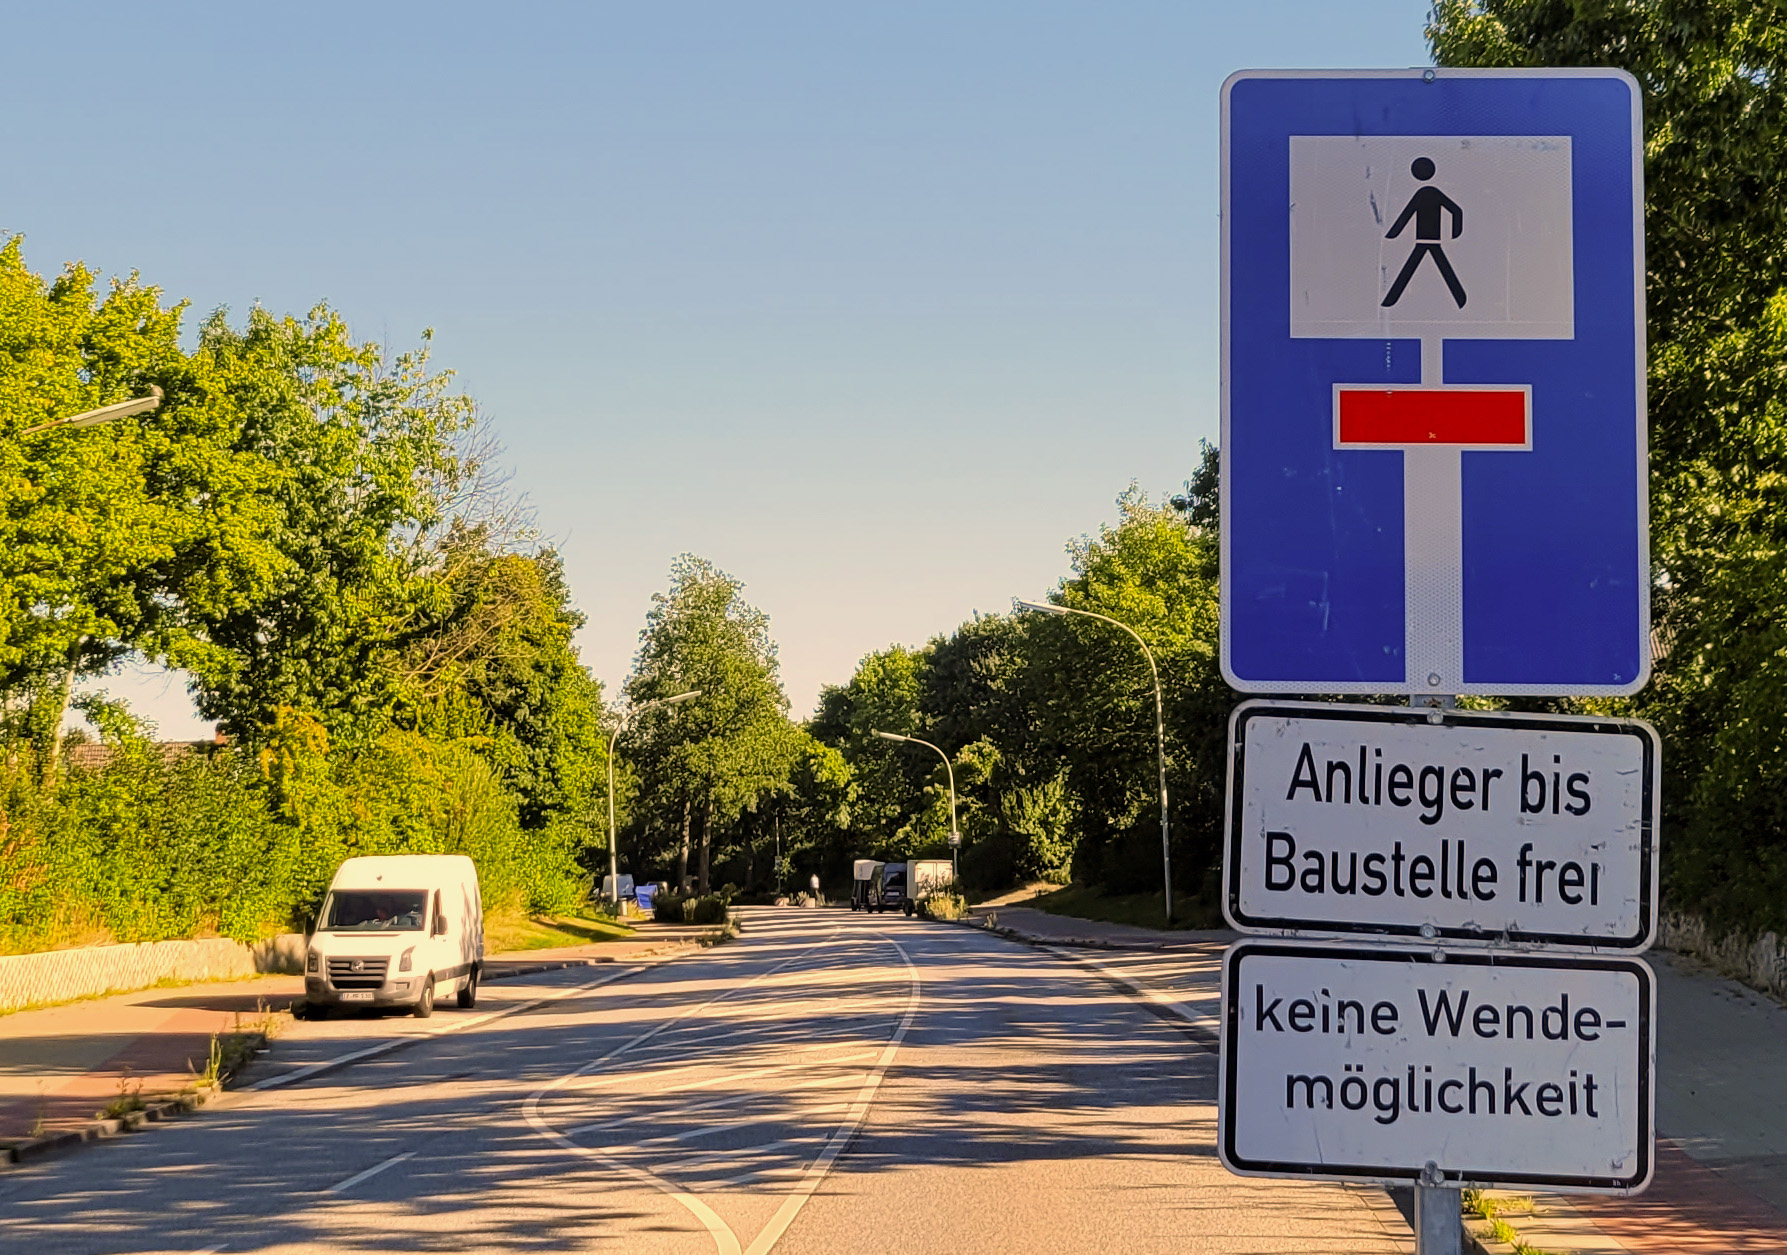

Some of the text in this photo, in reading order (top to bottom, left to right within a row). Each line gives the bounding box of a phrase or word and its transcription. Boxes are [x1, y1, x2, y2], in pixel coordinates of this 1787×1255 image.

[1286, 742, 1591, 825] Anlieger bis
[1265, 832, 1601, 906] Baustelle frei
[1256, 984, 1627, 1042] keine Wende-
[1287, 1064, 1599, 1125] möglichkeit
